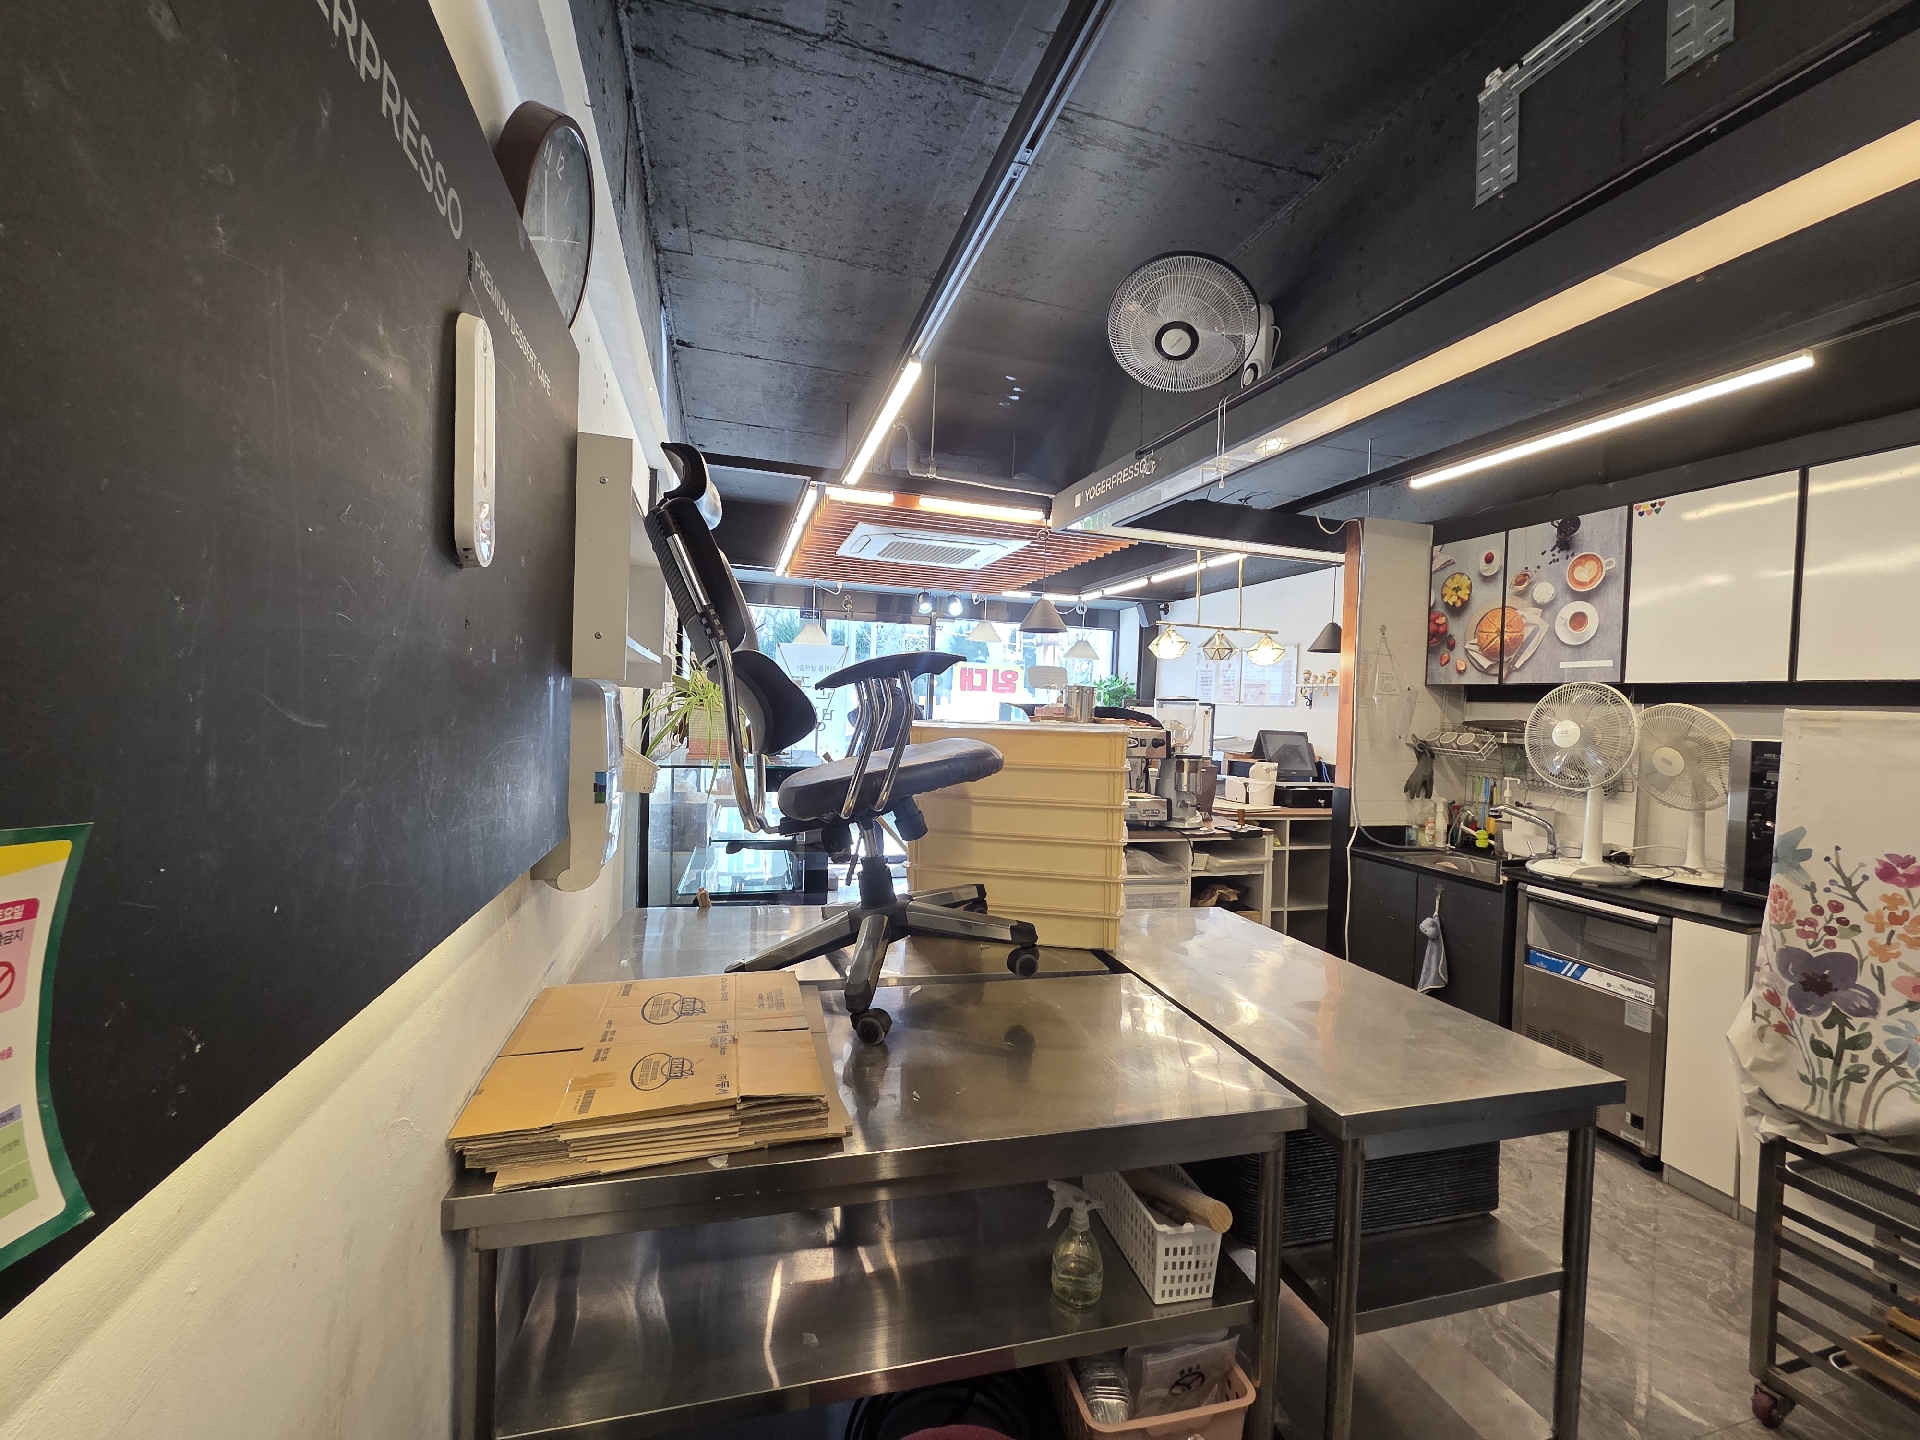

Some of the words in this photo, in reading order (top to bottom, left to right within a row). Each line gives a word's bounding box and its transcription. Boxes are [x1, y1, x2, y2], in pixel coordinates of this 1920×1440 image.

[474, 250, 511, 327] PREMIUM
[510, 314, 538, 372] DESSERT
[537, 361, 552, 397] CAFE
